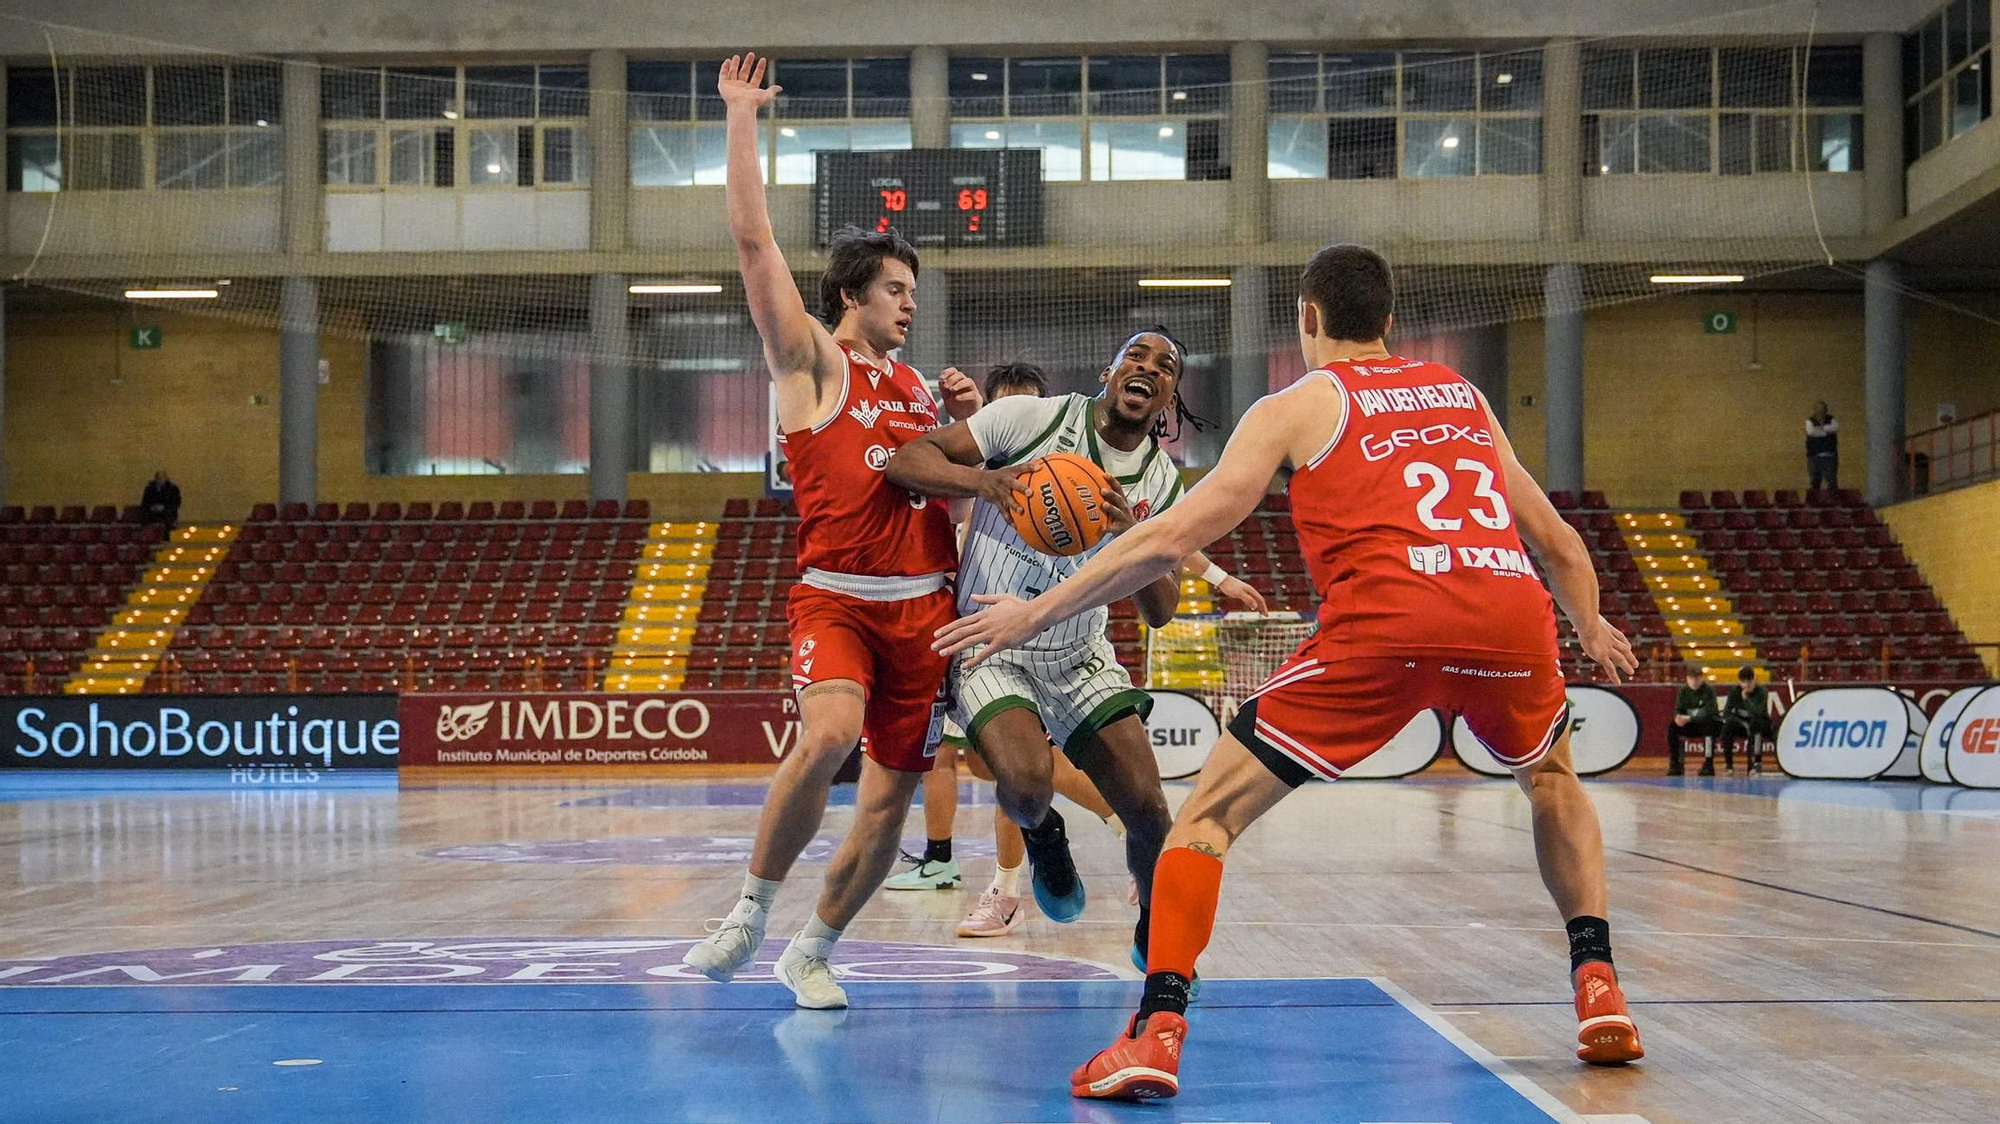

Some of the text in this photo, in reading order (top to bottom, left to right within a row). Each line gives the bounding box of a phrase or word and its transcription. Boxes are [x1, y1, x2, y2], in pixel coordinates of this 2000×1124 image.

[880, 190, 907, 211] 70
[958, 189, 988, 210] 69
[138, 329, 152, 347] K
[878, 400, 906, 413] CAJA
[1352, 388, 1391, 418] VAN
[1384, 385, 1421, 413] DER
[1360, 423, 1494, 462] Geoxa
[1403, 458, 1511, 531] 23
[1039, 481, 1074, 549] Wilson
[1493, 570, 1522, 579] GRUPO
[15, 702, 400, 767] SohoBoutique
[500, 698, 711, 741] IMDECO
[1795, 708, 1888, 749] simon
[1961, 718, 2000, 755] GE
[437, 746, 708, 764] Instituto Municipal de Deportes Córdoba
[228, 763, 320, 785] HOTELS
